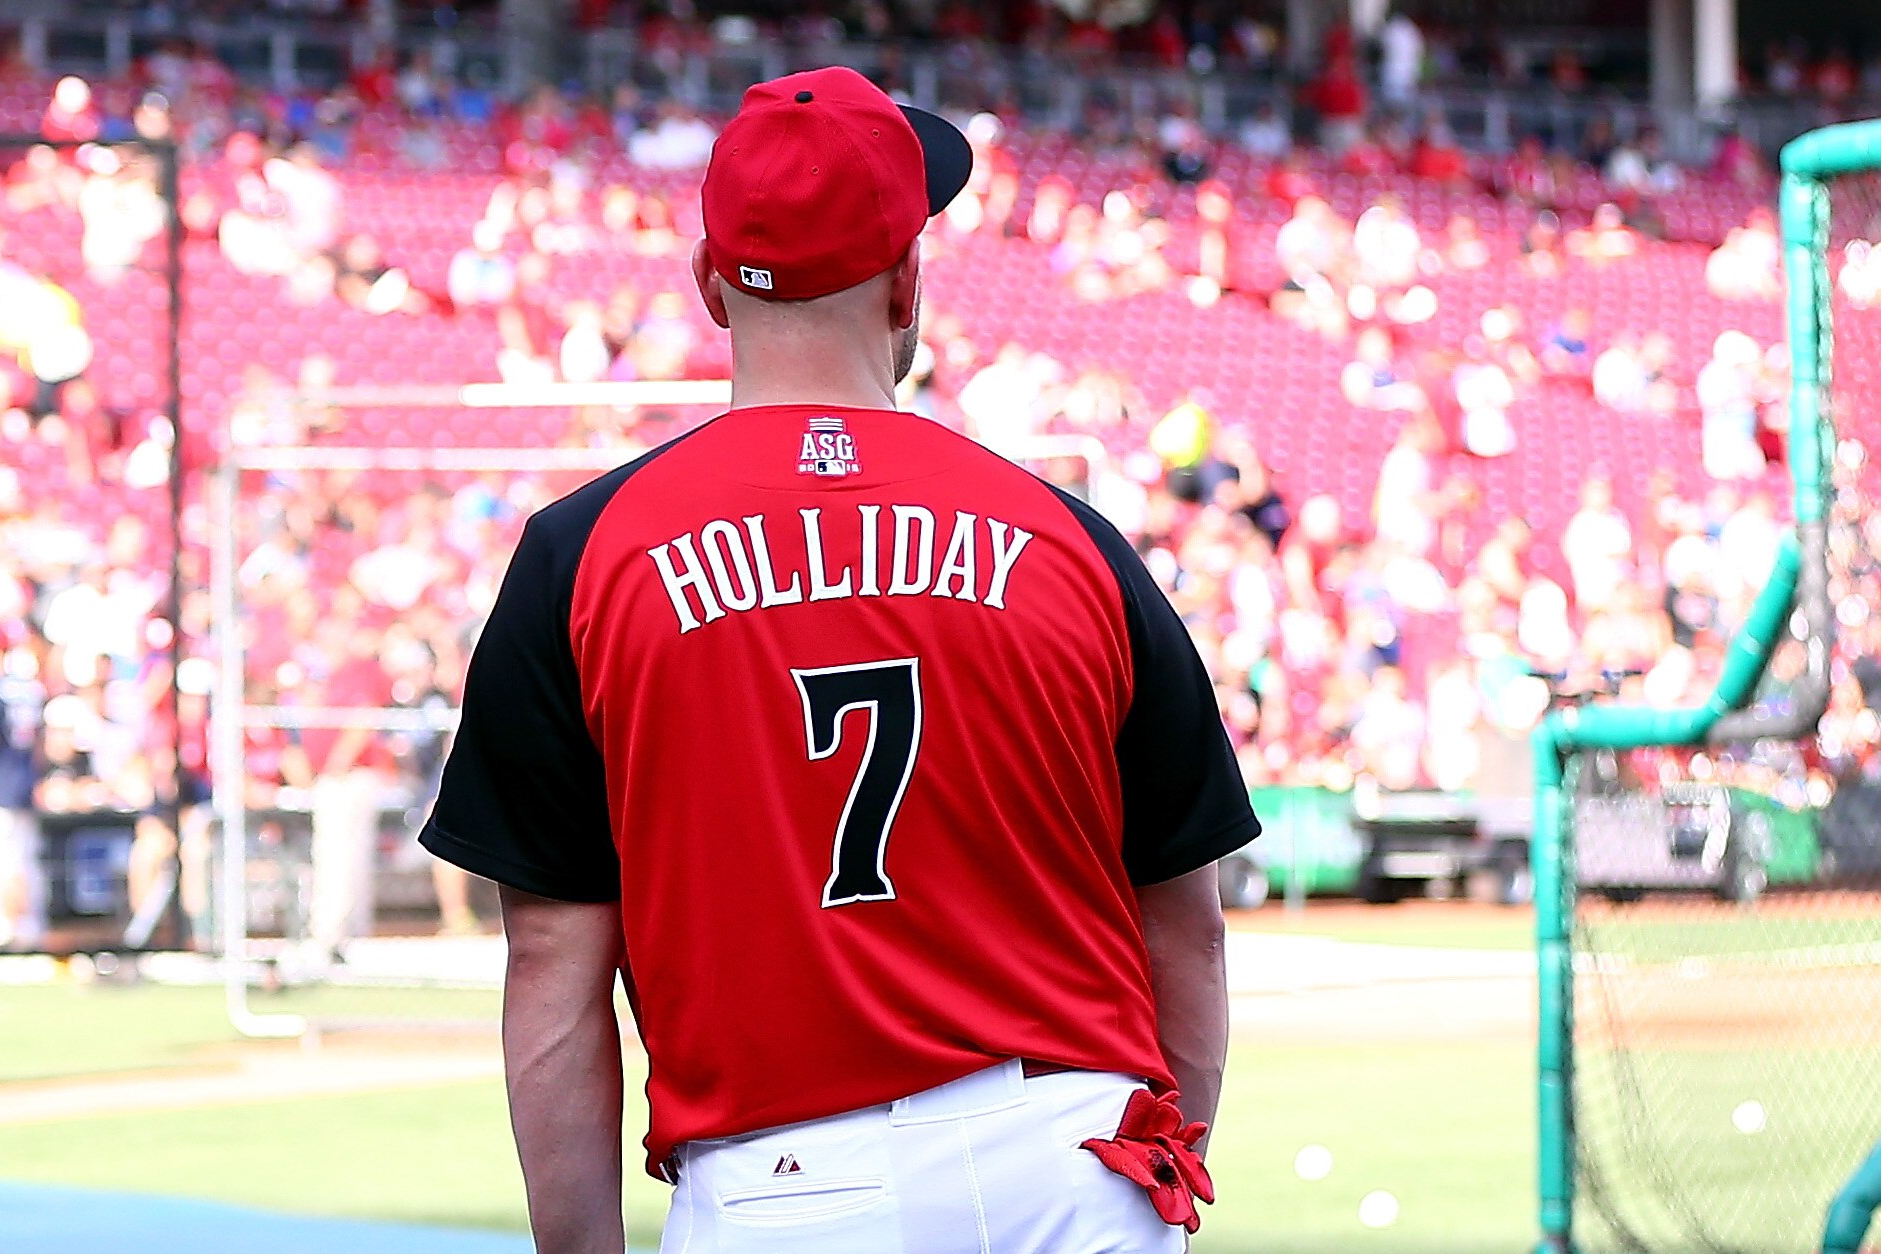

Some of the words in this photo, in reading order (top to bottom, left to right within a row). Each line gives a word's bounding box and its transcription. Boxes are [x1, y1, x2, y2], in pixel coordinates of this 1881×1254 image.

[800, 433, 855, 460] ASG
[647, 504, 1033, 633] HOLLIDAY
[790, 657, 921, 908] 7
